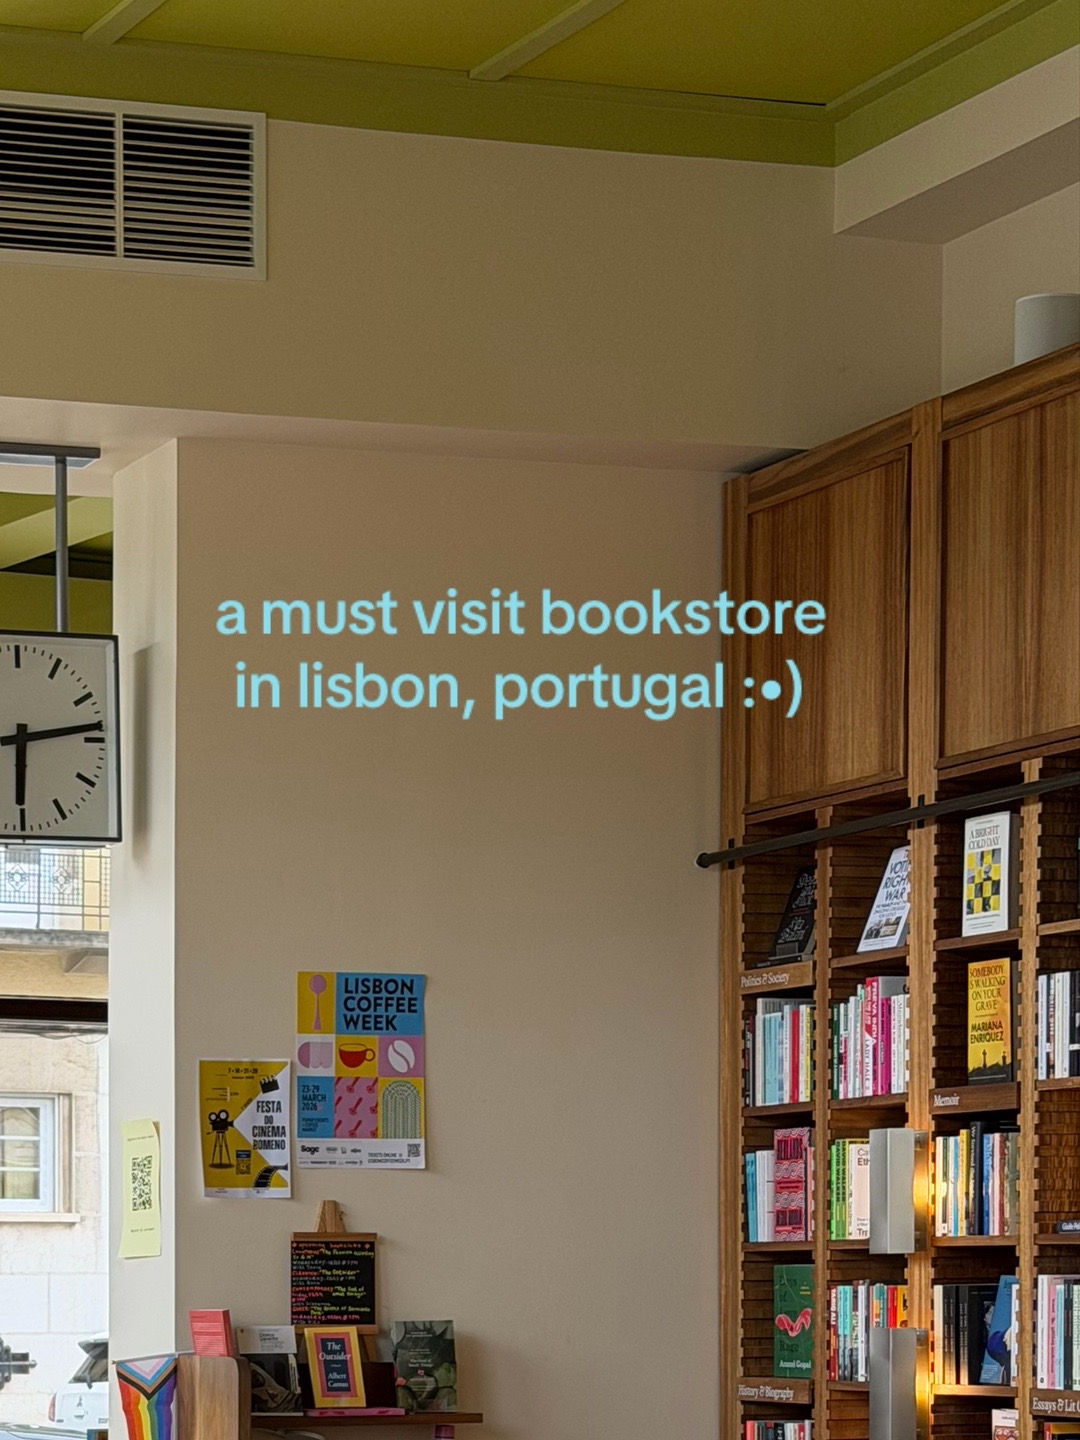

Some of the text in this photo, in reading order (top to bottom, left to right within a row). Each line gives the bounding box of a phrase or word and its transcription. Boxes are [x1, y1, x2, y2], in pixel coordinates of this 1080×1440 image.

[976, 825, 1000, 839] BRIGHT
[969, 835, 1000, 850] COLD DAY
[970, 964, 1004, 977] SOMEBODY
[741, 974, 762, 987] Politics
[768, 970, 790, 987] Society
[975, 976, 1006, 989] WALKING
[344, 977, 414, 995] LISBON
[971, 987, 1002, 1000] ON YOUR
[343, 996, 418, 1013] COFFEE
[975, 1000, 997, 1012] GRAVE
[343, 1014, 397, 1031] WEEK
[970, 1020, 1003, 1033] MARIANA
[970, 1031, 1004, 1044] ENRIQUEZ
[302, 1094, 326, 1102] MARCH
[933, 1094, 960, 1107] Memoir
[257, 1101, 282, 1113] FESTA
[264, 1116, 273, 1124] DO
[252, 1126, 286, 1138] CINEMA
[253, 1139, 286, 1150] ROMENO
[326, 1341, 341, 1350] The
[319, 1352, 351, 1360] Outsider
[738, 1386, 760, 1398] History
[765, 1386, 794, 1400] Biography
[1032, 1397, 1057, 1414] Essays
[1064, 1399, 1076, 1412] Lit
